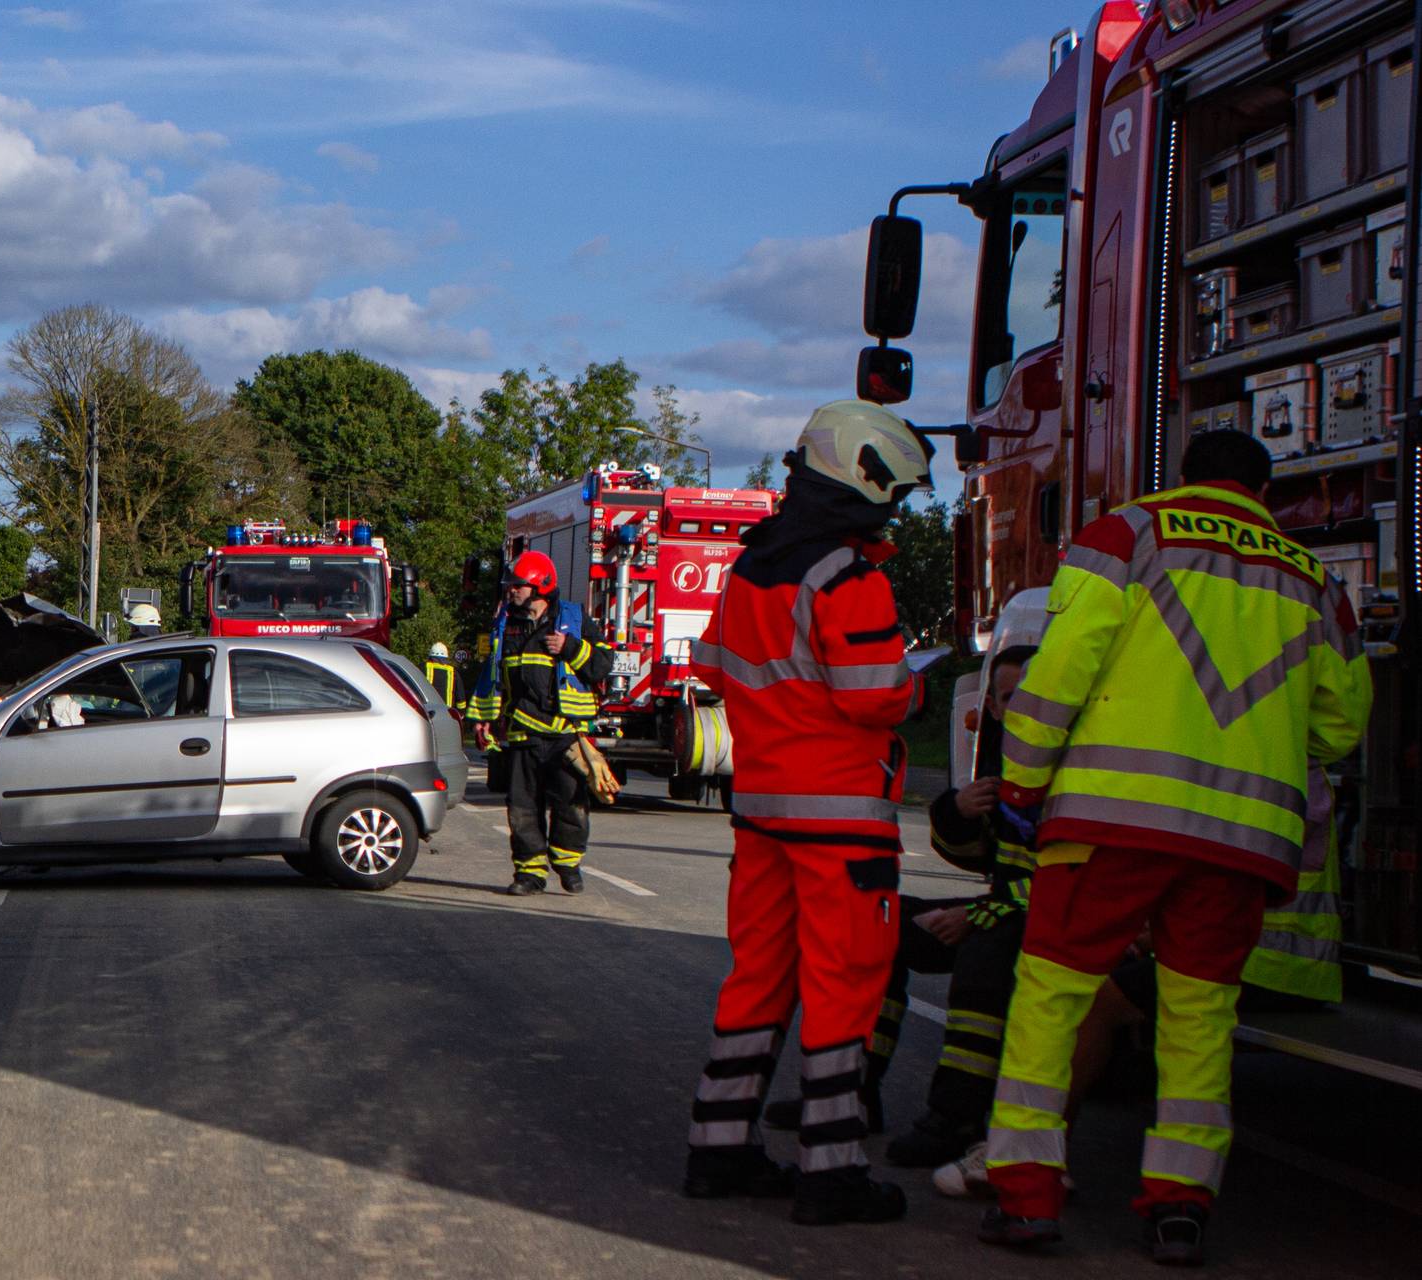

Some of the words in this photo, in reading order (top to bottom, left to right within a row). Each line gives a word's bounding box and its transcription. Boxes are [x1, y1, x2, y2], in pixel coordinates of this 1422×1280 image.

[1166, 511, 1321, 574] NOTARZT
[258, 625, 290, 634] IVECO
[292, 625, 342, 634] MAGIRUS
